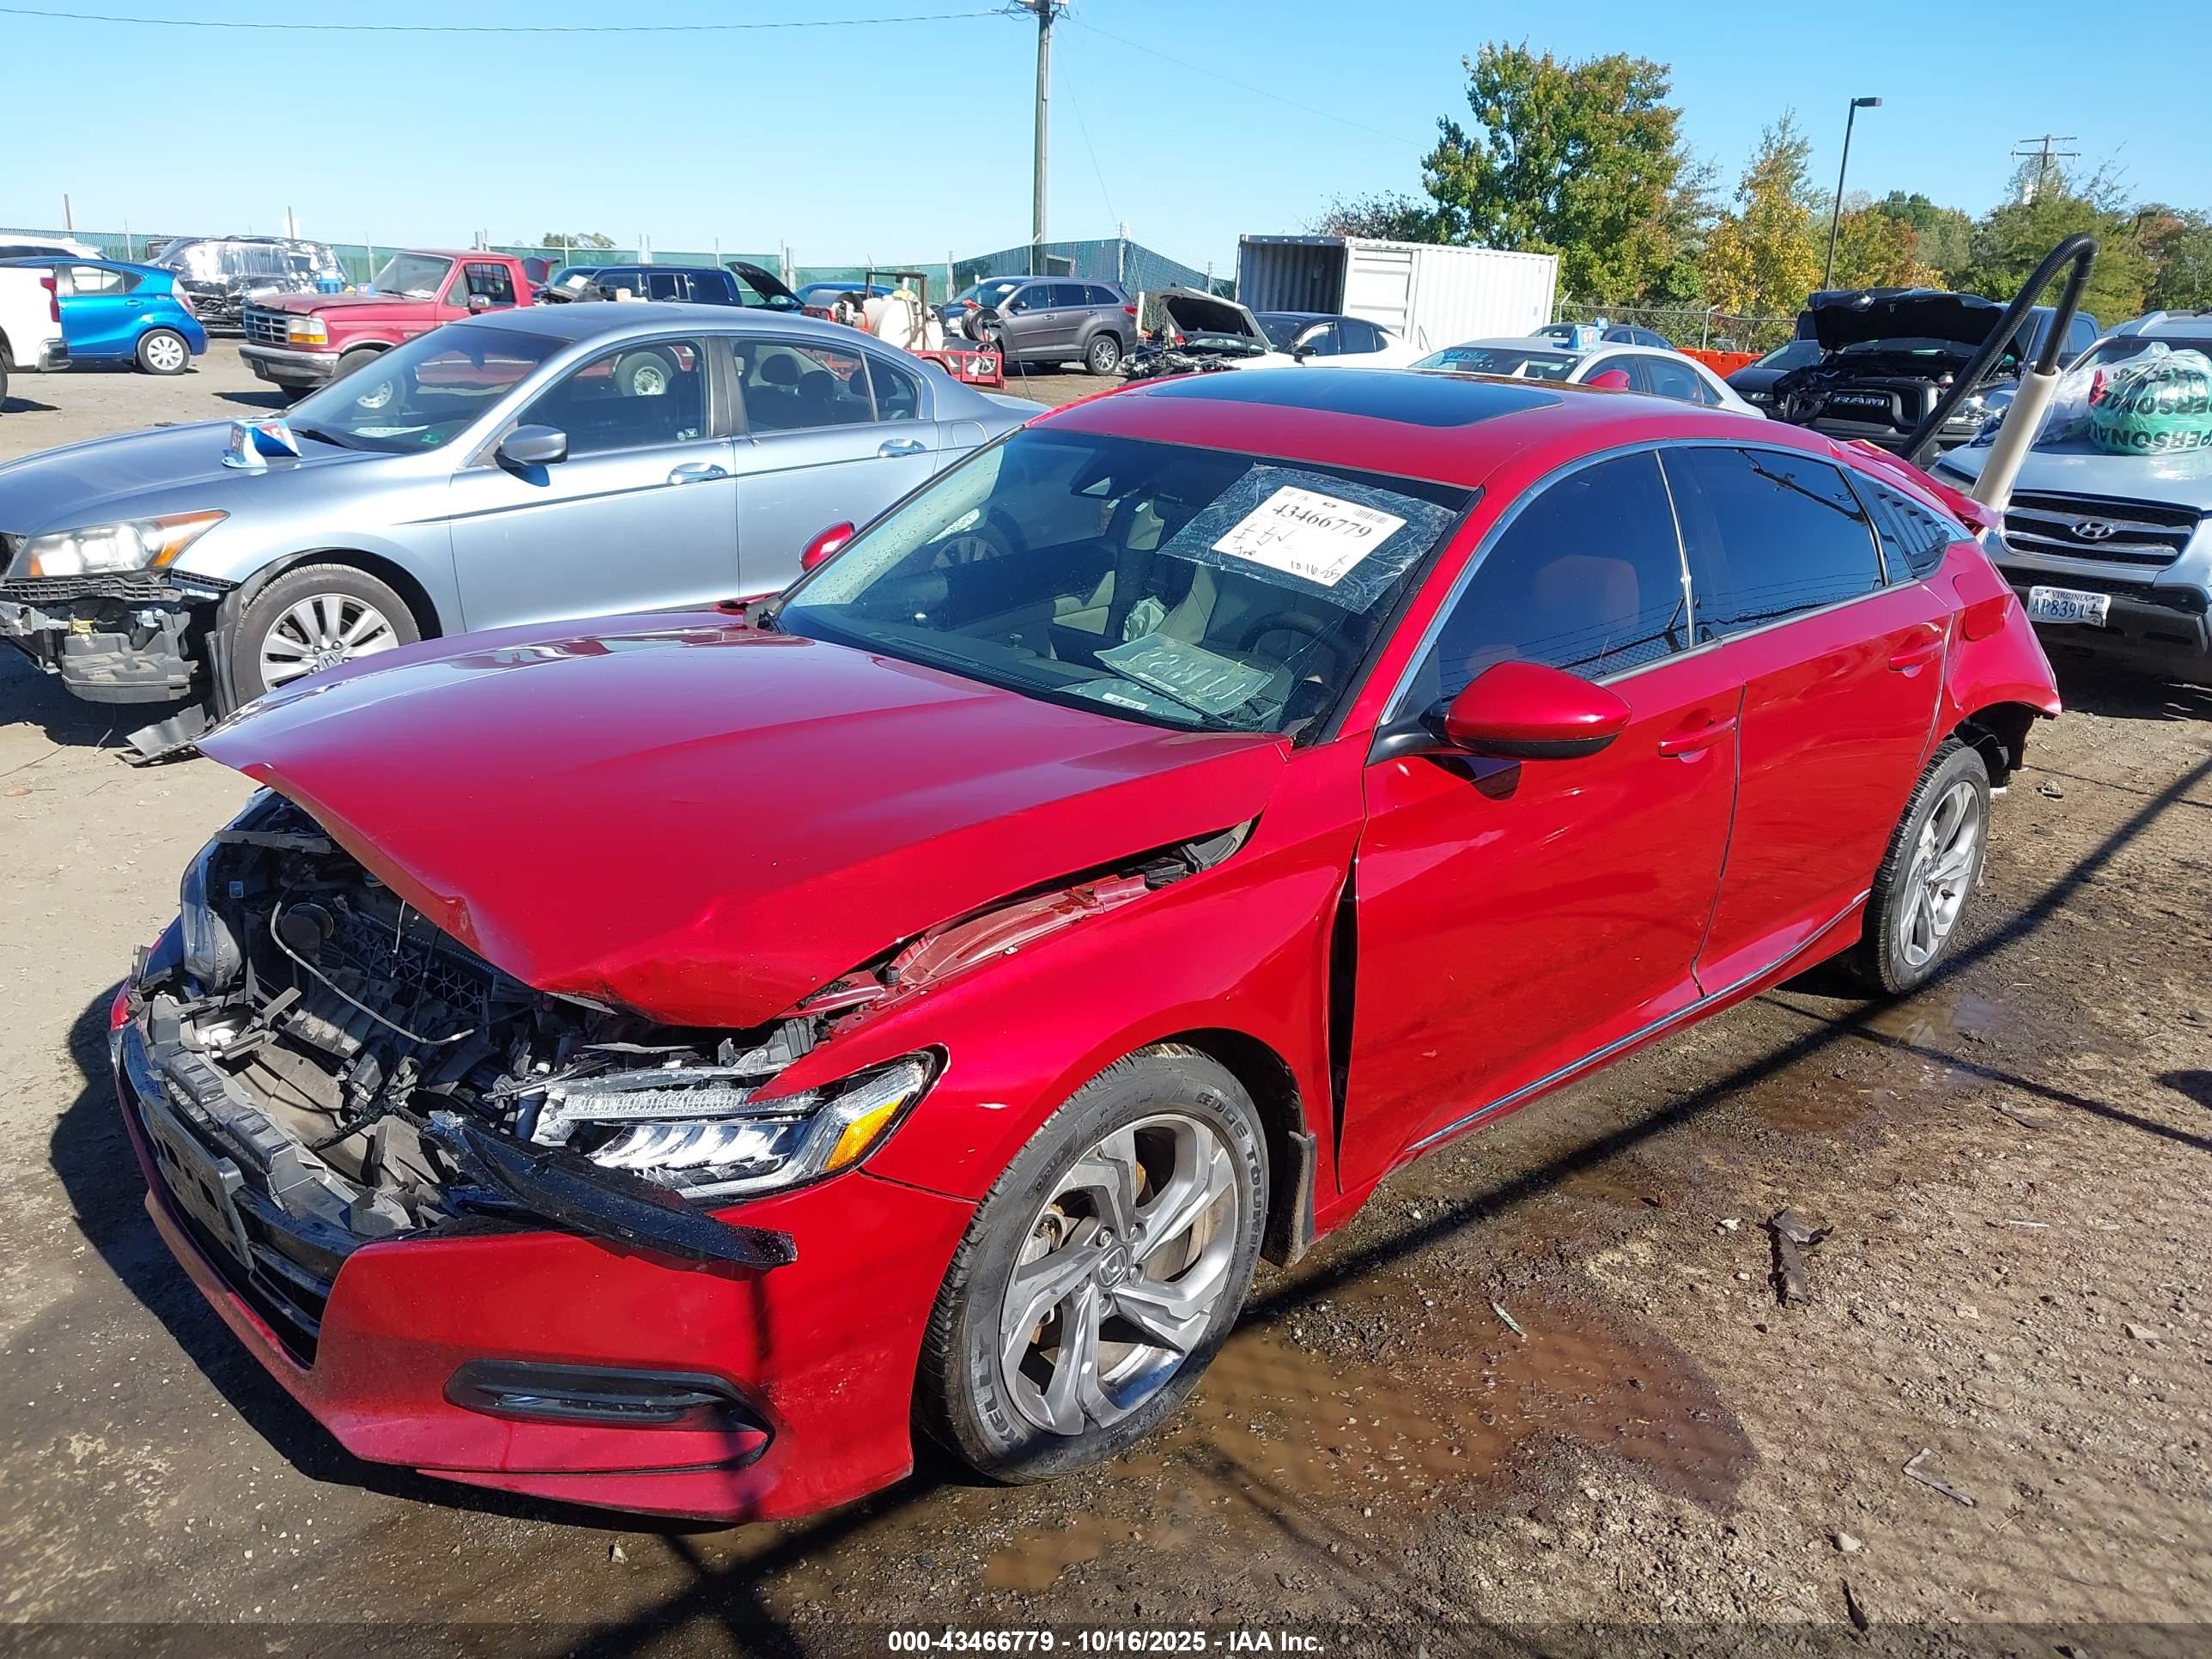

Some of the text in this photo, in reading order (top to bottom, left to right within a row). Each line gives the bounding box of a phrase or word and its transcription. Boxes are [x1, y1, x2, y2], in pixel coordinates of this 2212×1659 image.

[1833, 396, 1885, 406] RAM
[1273, 503, 1373, 538] 43466779
[2032, 597, 2087, 619] AP8391
[2052, 591, 2089, 602] VIRGINIA
[1195, 1091, 1249, 1139] EDGE
[977, 1334, 1024, 1449] KELLY
